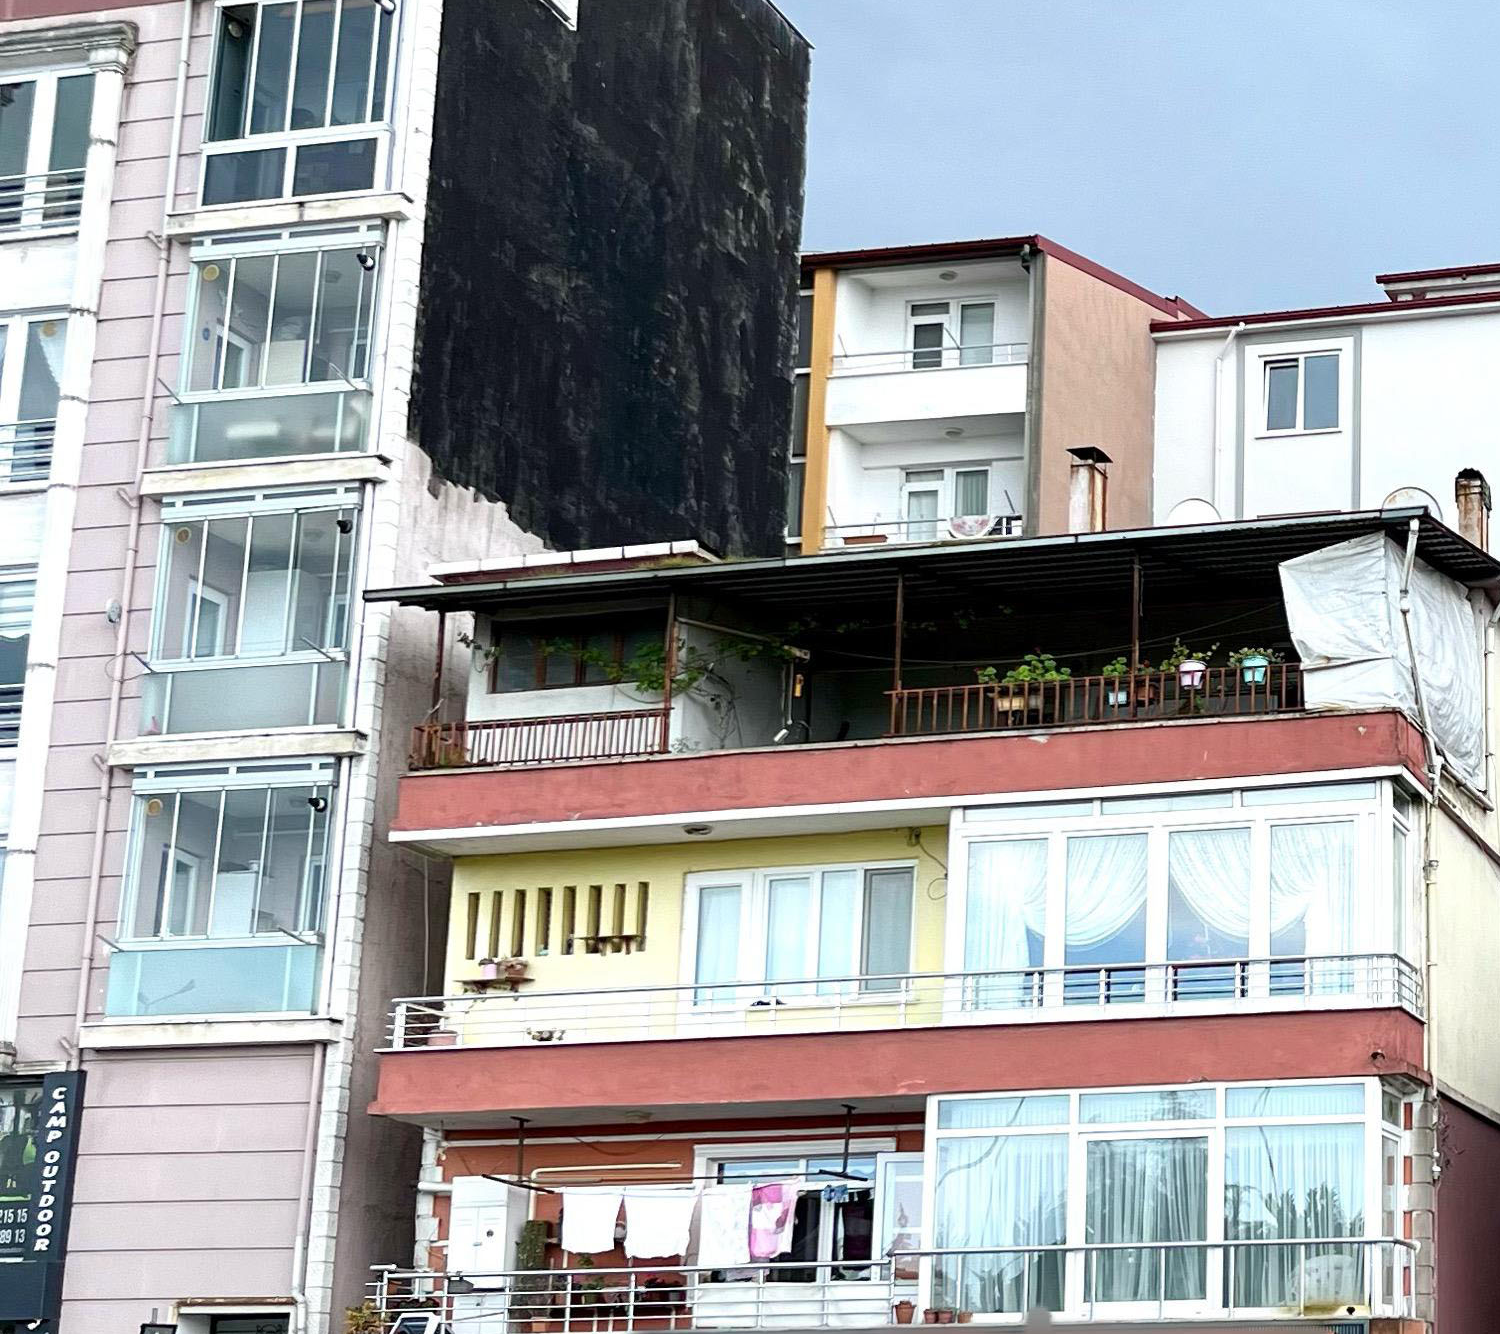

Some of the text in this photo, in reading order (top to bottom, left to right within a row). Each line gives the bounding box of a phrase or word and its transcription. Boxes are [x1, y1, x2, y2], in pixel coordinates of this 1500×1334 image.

[34, 1087, 67, 1251] CAMP OUTDOOR
[17, 1208, 28, 1223] 15
[15, 1228, 26, 1243] 13
